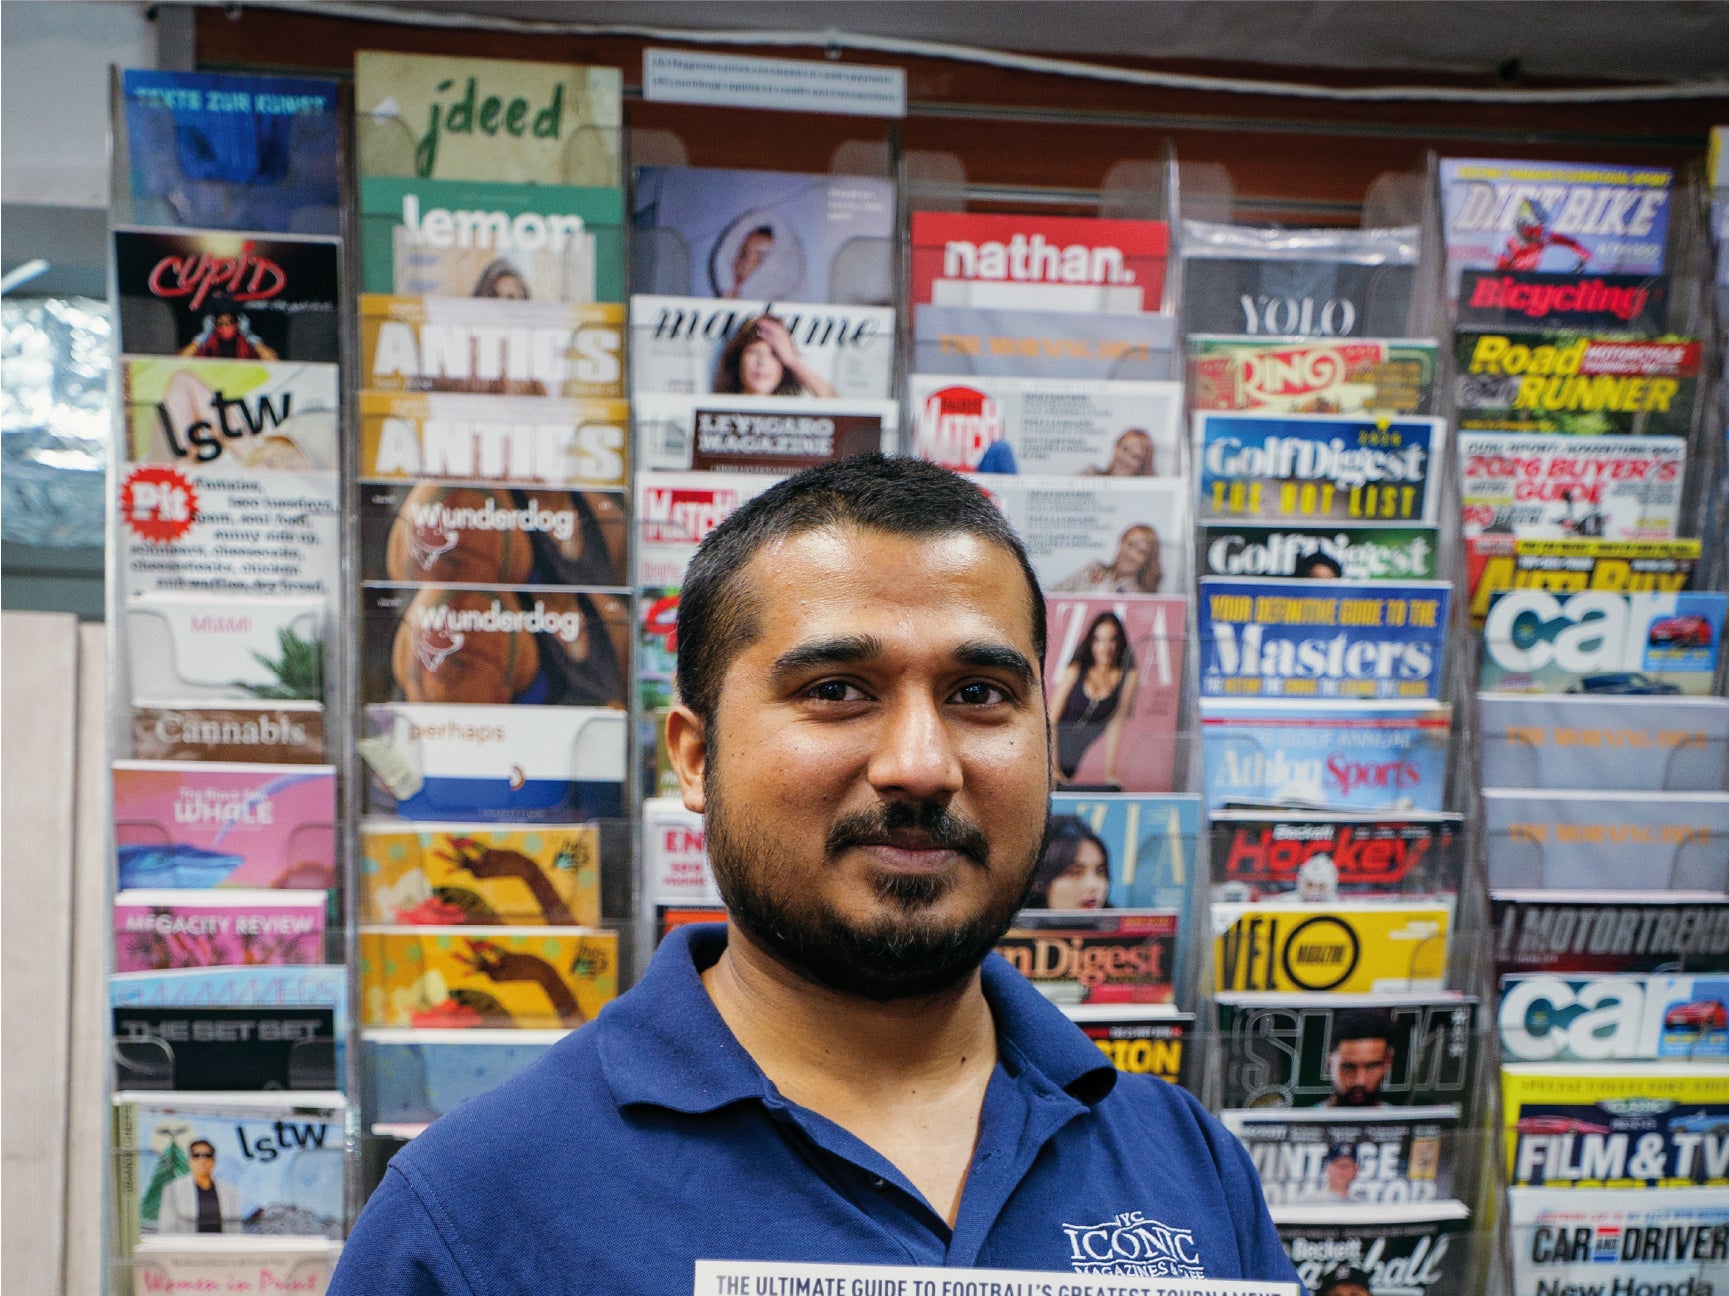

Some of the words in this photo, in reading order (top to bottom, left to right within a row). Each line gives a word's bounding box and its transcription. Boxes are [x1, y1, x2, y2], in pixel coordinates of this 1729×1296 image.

[206, 90, 251, 112] ZUR
[415, 76, 565, 179] jdeed
[401, 193, 586, 251] lemon
[1552, 186, 1670, 236] BIKE
[942, 233, 1137, 284] nathan.
[1468, 275, 1651, 321] Bicycling
[654, 302, 881, 348] maame
[1468, 335, 1590, 377] Road
[1514, 374, 1680, 413] RUNNER
[1465, 454, 1543, 479] 2026
[130, 481, 190, 522] Pit
[411, 497, 577, 541] Wunderdog
[1211, 480, 1264, 514] THE
[1279, 482, 1337, 515] HOT
[1348, 485, 1417, 518] LIST
[416, 599, 581, 643] Wunderdog
[1484, 588, 1680, 674] car
[1208, 621, 1434, 681] Masters
[154, 712, 307, 746] Cannabis
[406, 719, 507, 745] perhaps
[1215, 748, 1324, 789] Athlon
[1324, 750, 1421, 796] Sports
[173, 801, 275, 825] WHALE
[126, 914, 231, 936] MEGACITY
[235, 914, 314, 935] REVIEW
[1500, 976, 1695, 1061] car
[1241, 1005, 1471, 1096] SLM
[1250, 1141, 1403, 1181] VINTGE
[1516, 1133, 1630, 1181] FILM
[1627, 1132, 1668, 1181] &
[1063, 1227, 1201, 1265] ICONIC
[1531, 1226, 1592, 1264] CAR
[1620, 1223, 1729, 1263] DRIVER
[143, 1268, 220, 1293] Women
[227, 1269, 252, 1292] in
[259, 1267, 318, 1293] Print
[715, 1275, 750, 1296] THE
